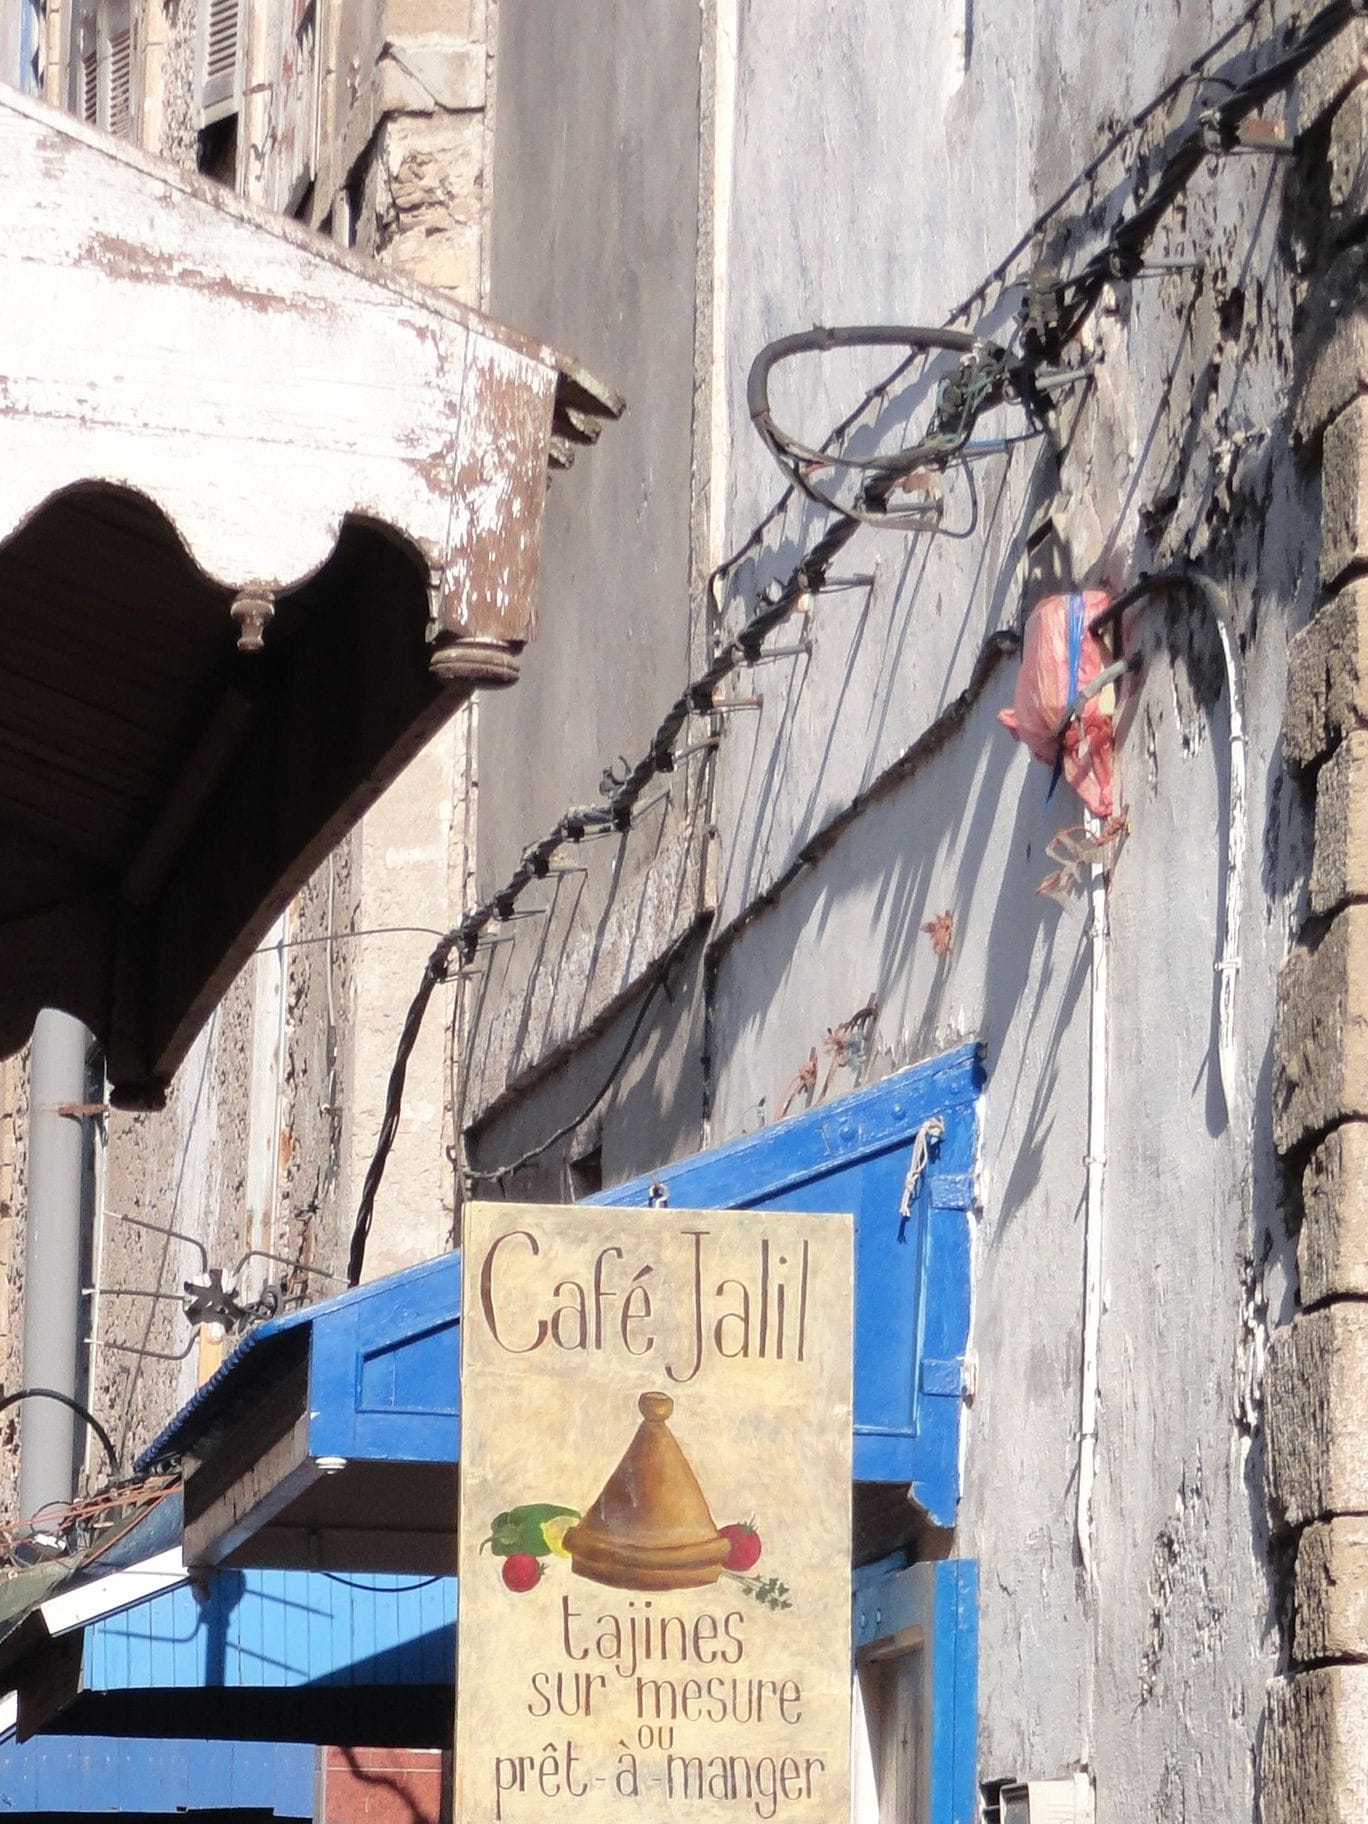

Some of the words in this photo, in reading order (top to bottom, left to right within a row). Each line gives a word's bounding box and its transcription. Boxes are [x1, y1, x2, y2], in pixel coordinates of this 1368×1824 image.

[480, 1230, 655, 1355] Café
[665, 1230, 810, 1383] Jalil
[562, 1594, 745, 1679] tajines
[527, 1671, 607, 1718] sur
[636, 1675, 803, 1726] mesure
[637, 1724, 675, 1752] ou
